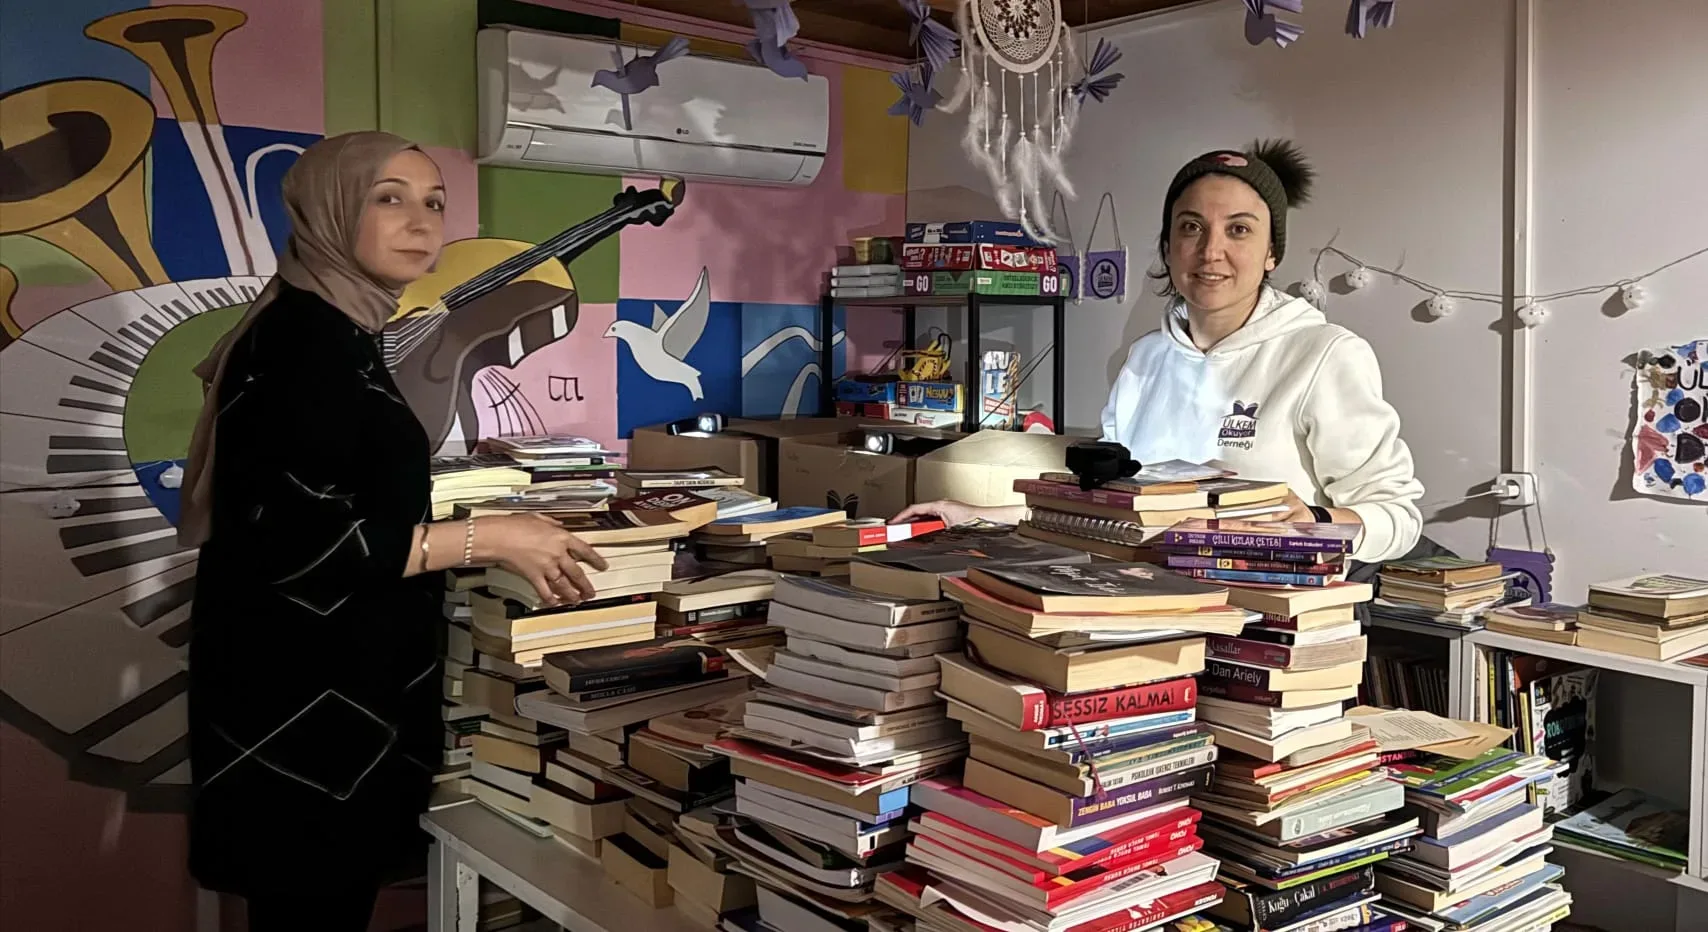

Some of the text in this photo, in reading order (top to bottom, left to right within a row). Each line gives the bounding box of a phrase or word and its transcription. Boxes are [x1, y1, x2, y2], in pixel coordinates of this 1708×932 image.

[916, 275, 929, 292] GO
[1043, 276, 1058, 293] GO
[1222, 416, 1256, 430] ÜLKEM
[1221, 429, 1253, 438] Okuyor
[1217, 438, 1254, 450] Derneği
[1212, 662, 1262, 687] Dan Ariely
[1137, 789, 1153, 802] BABA
[1169, 830, 1187, 842] FONO
[1177, 844, 1195, 856] FONO
[1267, 896, 1289, 914] Kuğu
[1293, 884, 1315, 906] Çakal
